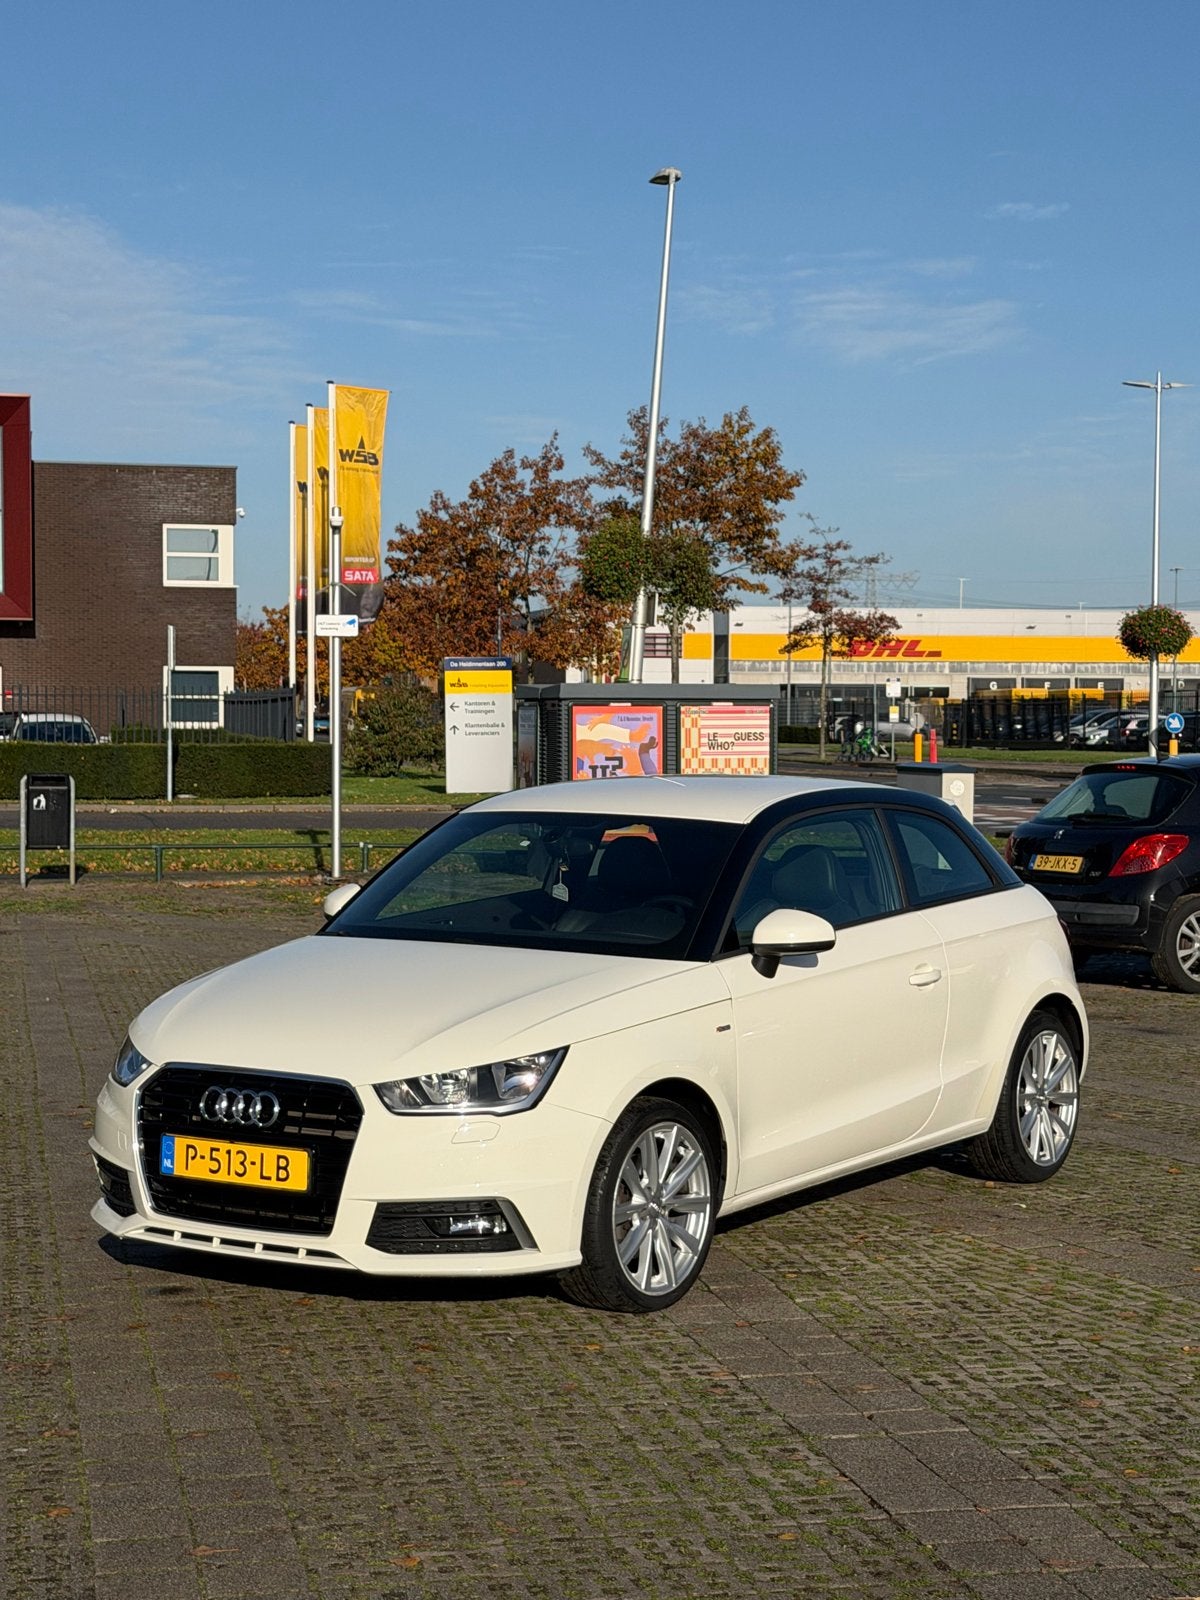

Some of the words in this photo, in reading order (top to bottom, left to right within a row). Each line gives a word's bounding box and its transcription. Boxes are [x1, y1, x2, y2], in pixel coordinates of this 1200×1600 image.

[339, 448, 379, 466] WSB
[344, 570, 375, 581] SATA
[849, 639, 926, 658] DHL
[989, 681, 998, 691] G
[707, 732, 719, 741] LE
[733, 732, 765, 741] GUESS
[707, 741, 735, 750] WHO?
[1036, 856, 1078, 870] 39-JKX-5
[163, 1159, 173, 1168] NL
[185, 1144, 290, 1182] P-513-LB
